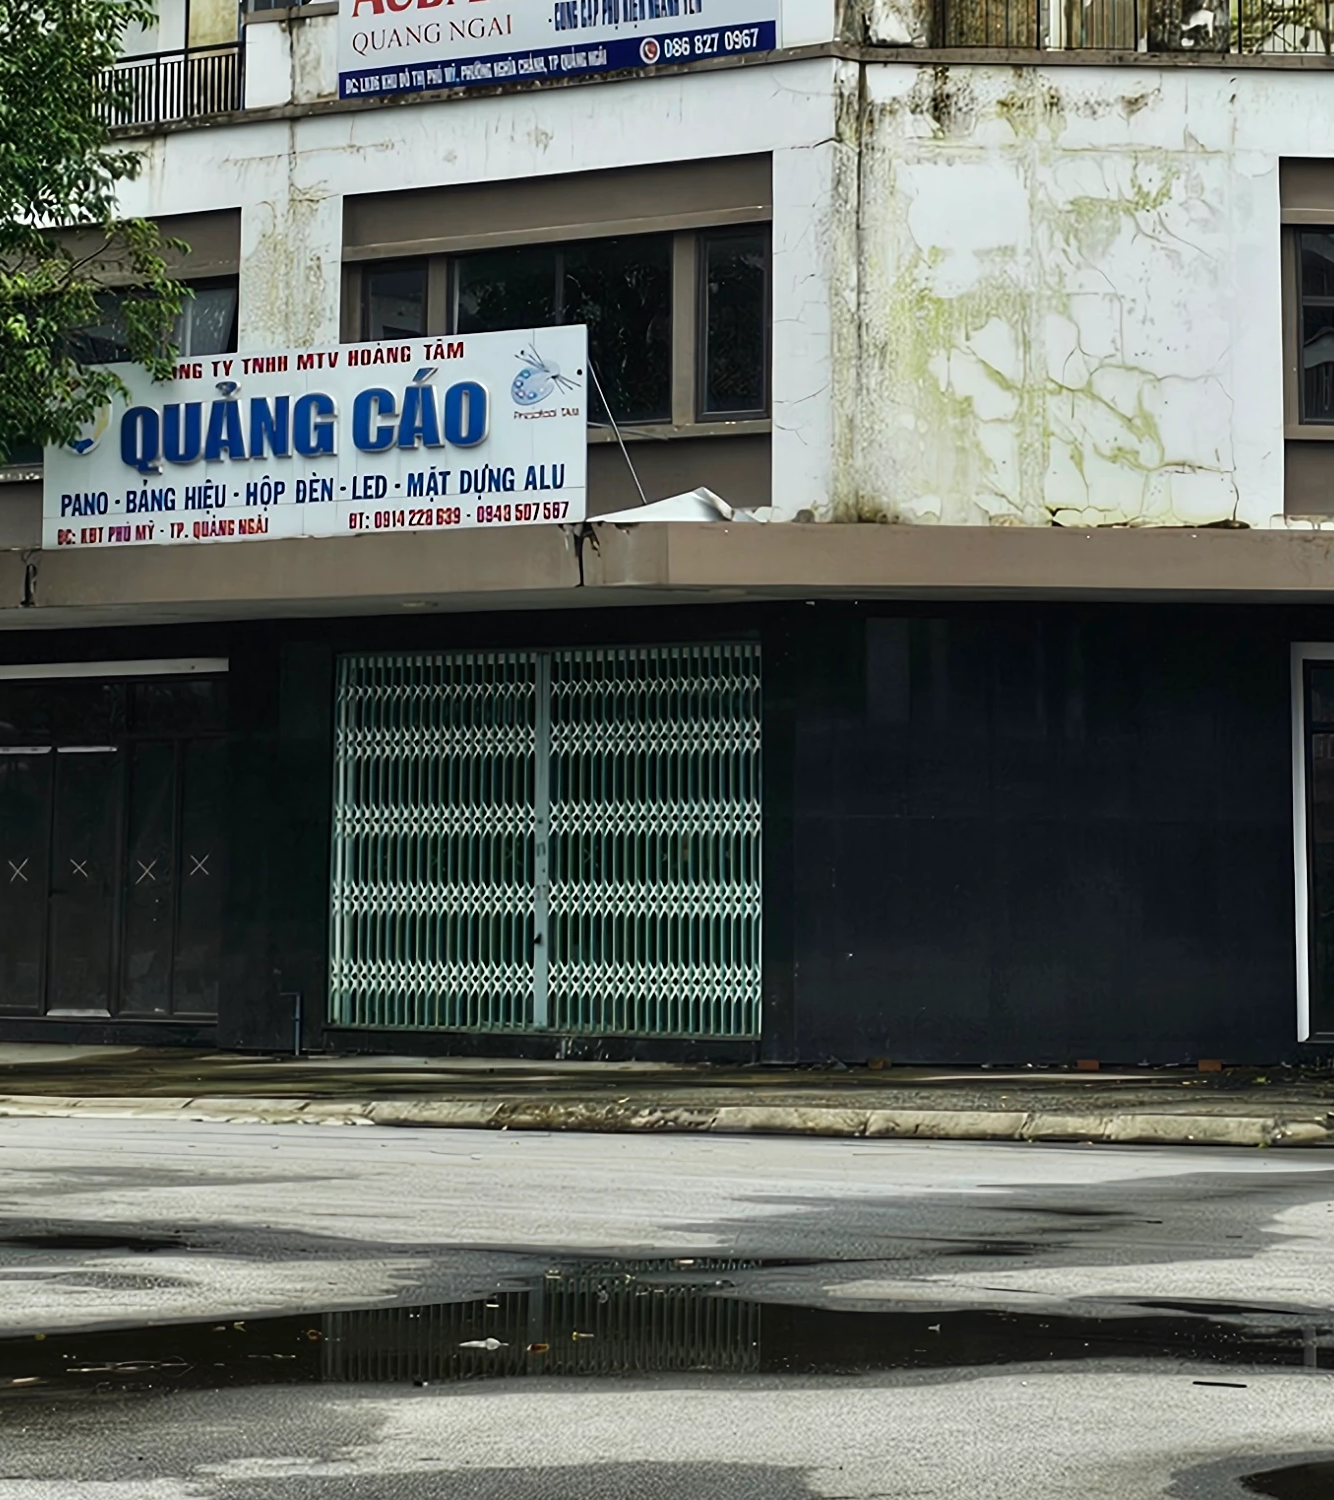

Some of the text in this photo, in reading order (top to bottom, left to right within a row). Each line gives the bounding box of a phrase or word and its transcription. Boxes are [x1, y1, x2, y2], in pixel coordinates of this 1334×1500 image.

[352, 14, 513, 57] QUANG NGAI
[663, 28, 760, 58] 086 827 0967
[211, 360, 234, 378] TY
[241, 355, 288, 375] TNHH
[296, 351, 339, 371] MTV
[347, 342, 411, 367] HOÀNG
[423, 338, 465, 360] TÂM
[120, 367, 490, 475] QUẢNG CÁO
[60, 463, 565, 517] PANO BẢNG HIỆU HỘP ĐÈN LED MẶT DỰNG ALU
[374, 510, 405, 529] 0914
[515, 502, 540, 521] 507
